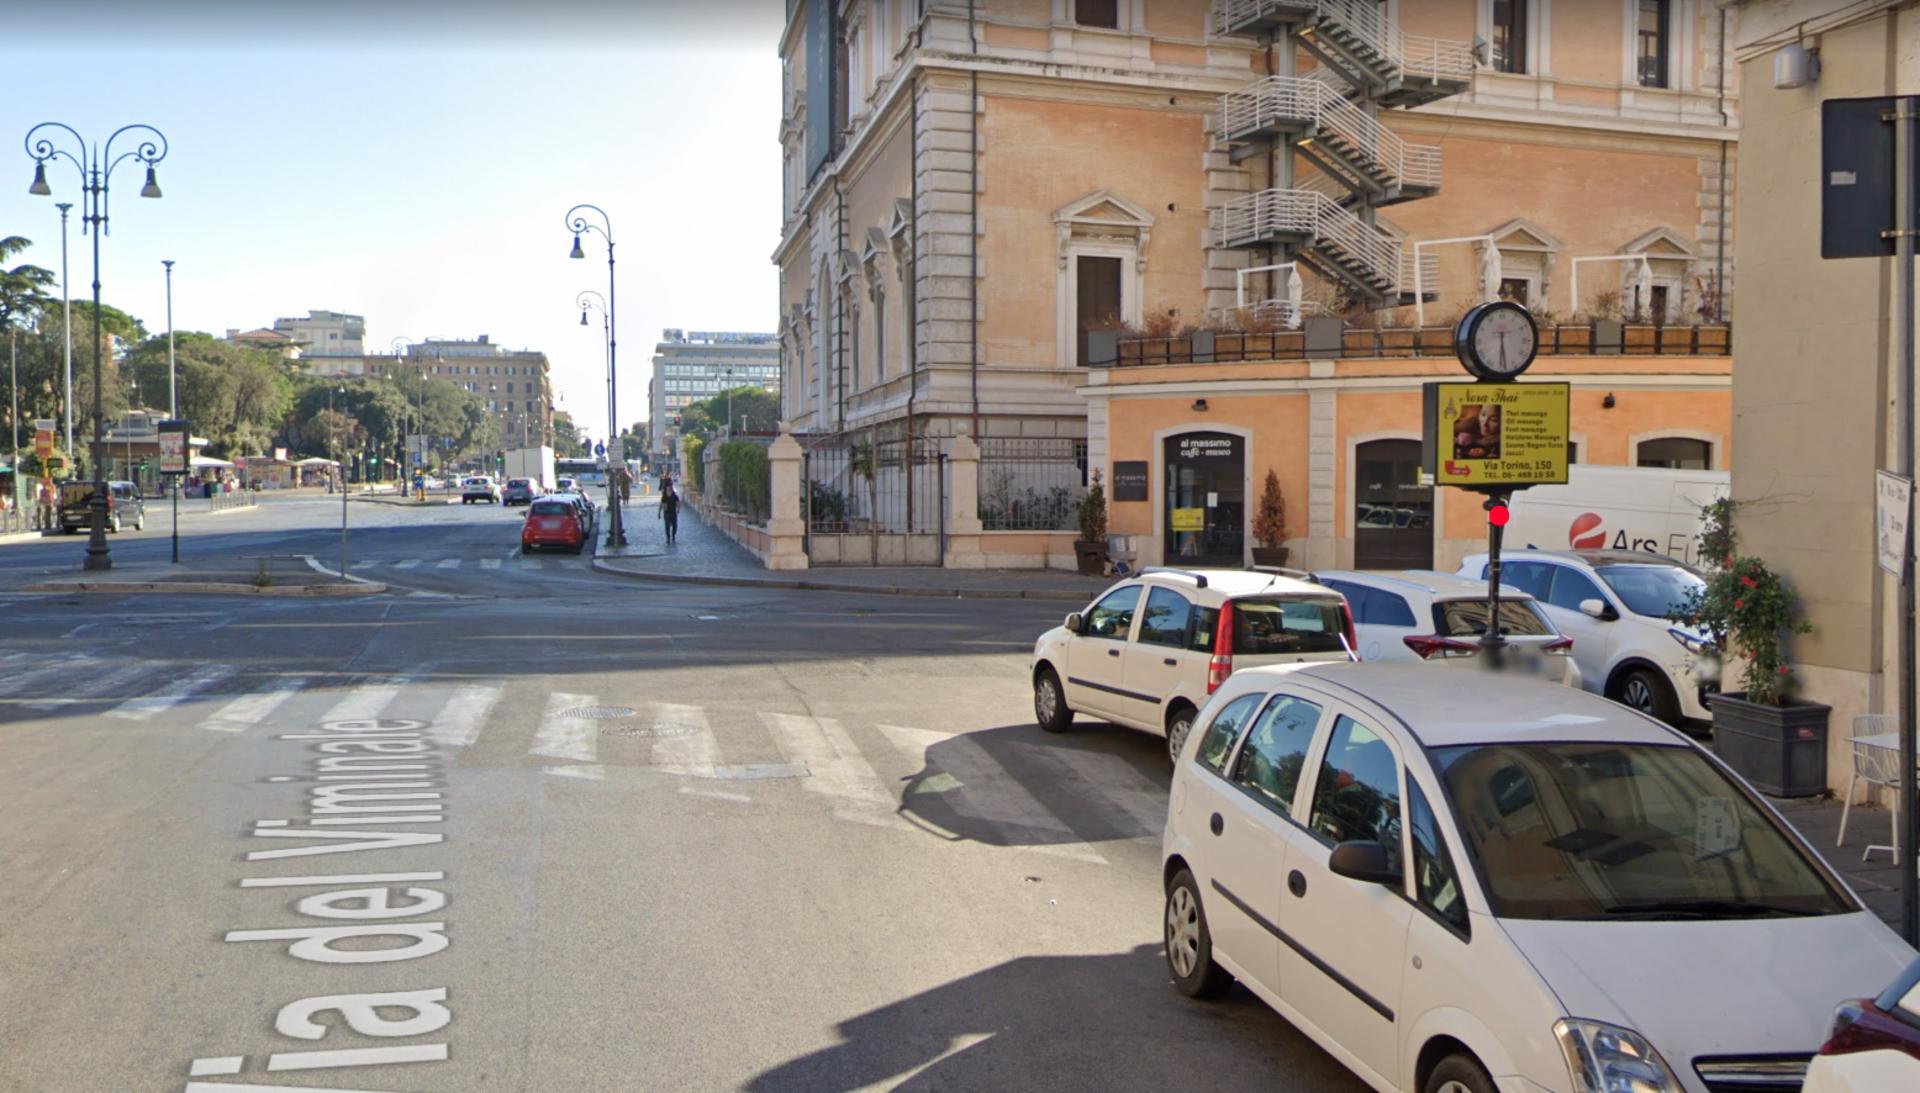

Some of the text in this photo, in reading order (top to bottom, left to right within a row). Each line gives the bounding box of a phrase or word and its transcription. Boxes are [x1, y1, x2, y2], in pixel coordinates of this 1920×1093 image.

[1491, 388, 1519, 403] Thai
[1180, 439, 1232, 448] al massimo
[1483, 460, 1552, 471] Via Torino, 150
[1613, 529, 1657, 553] Ars
